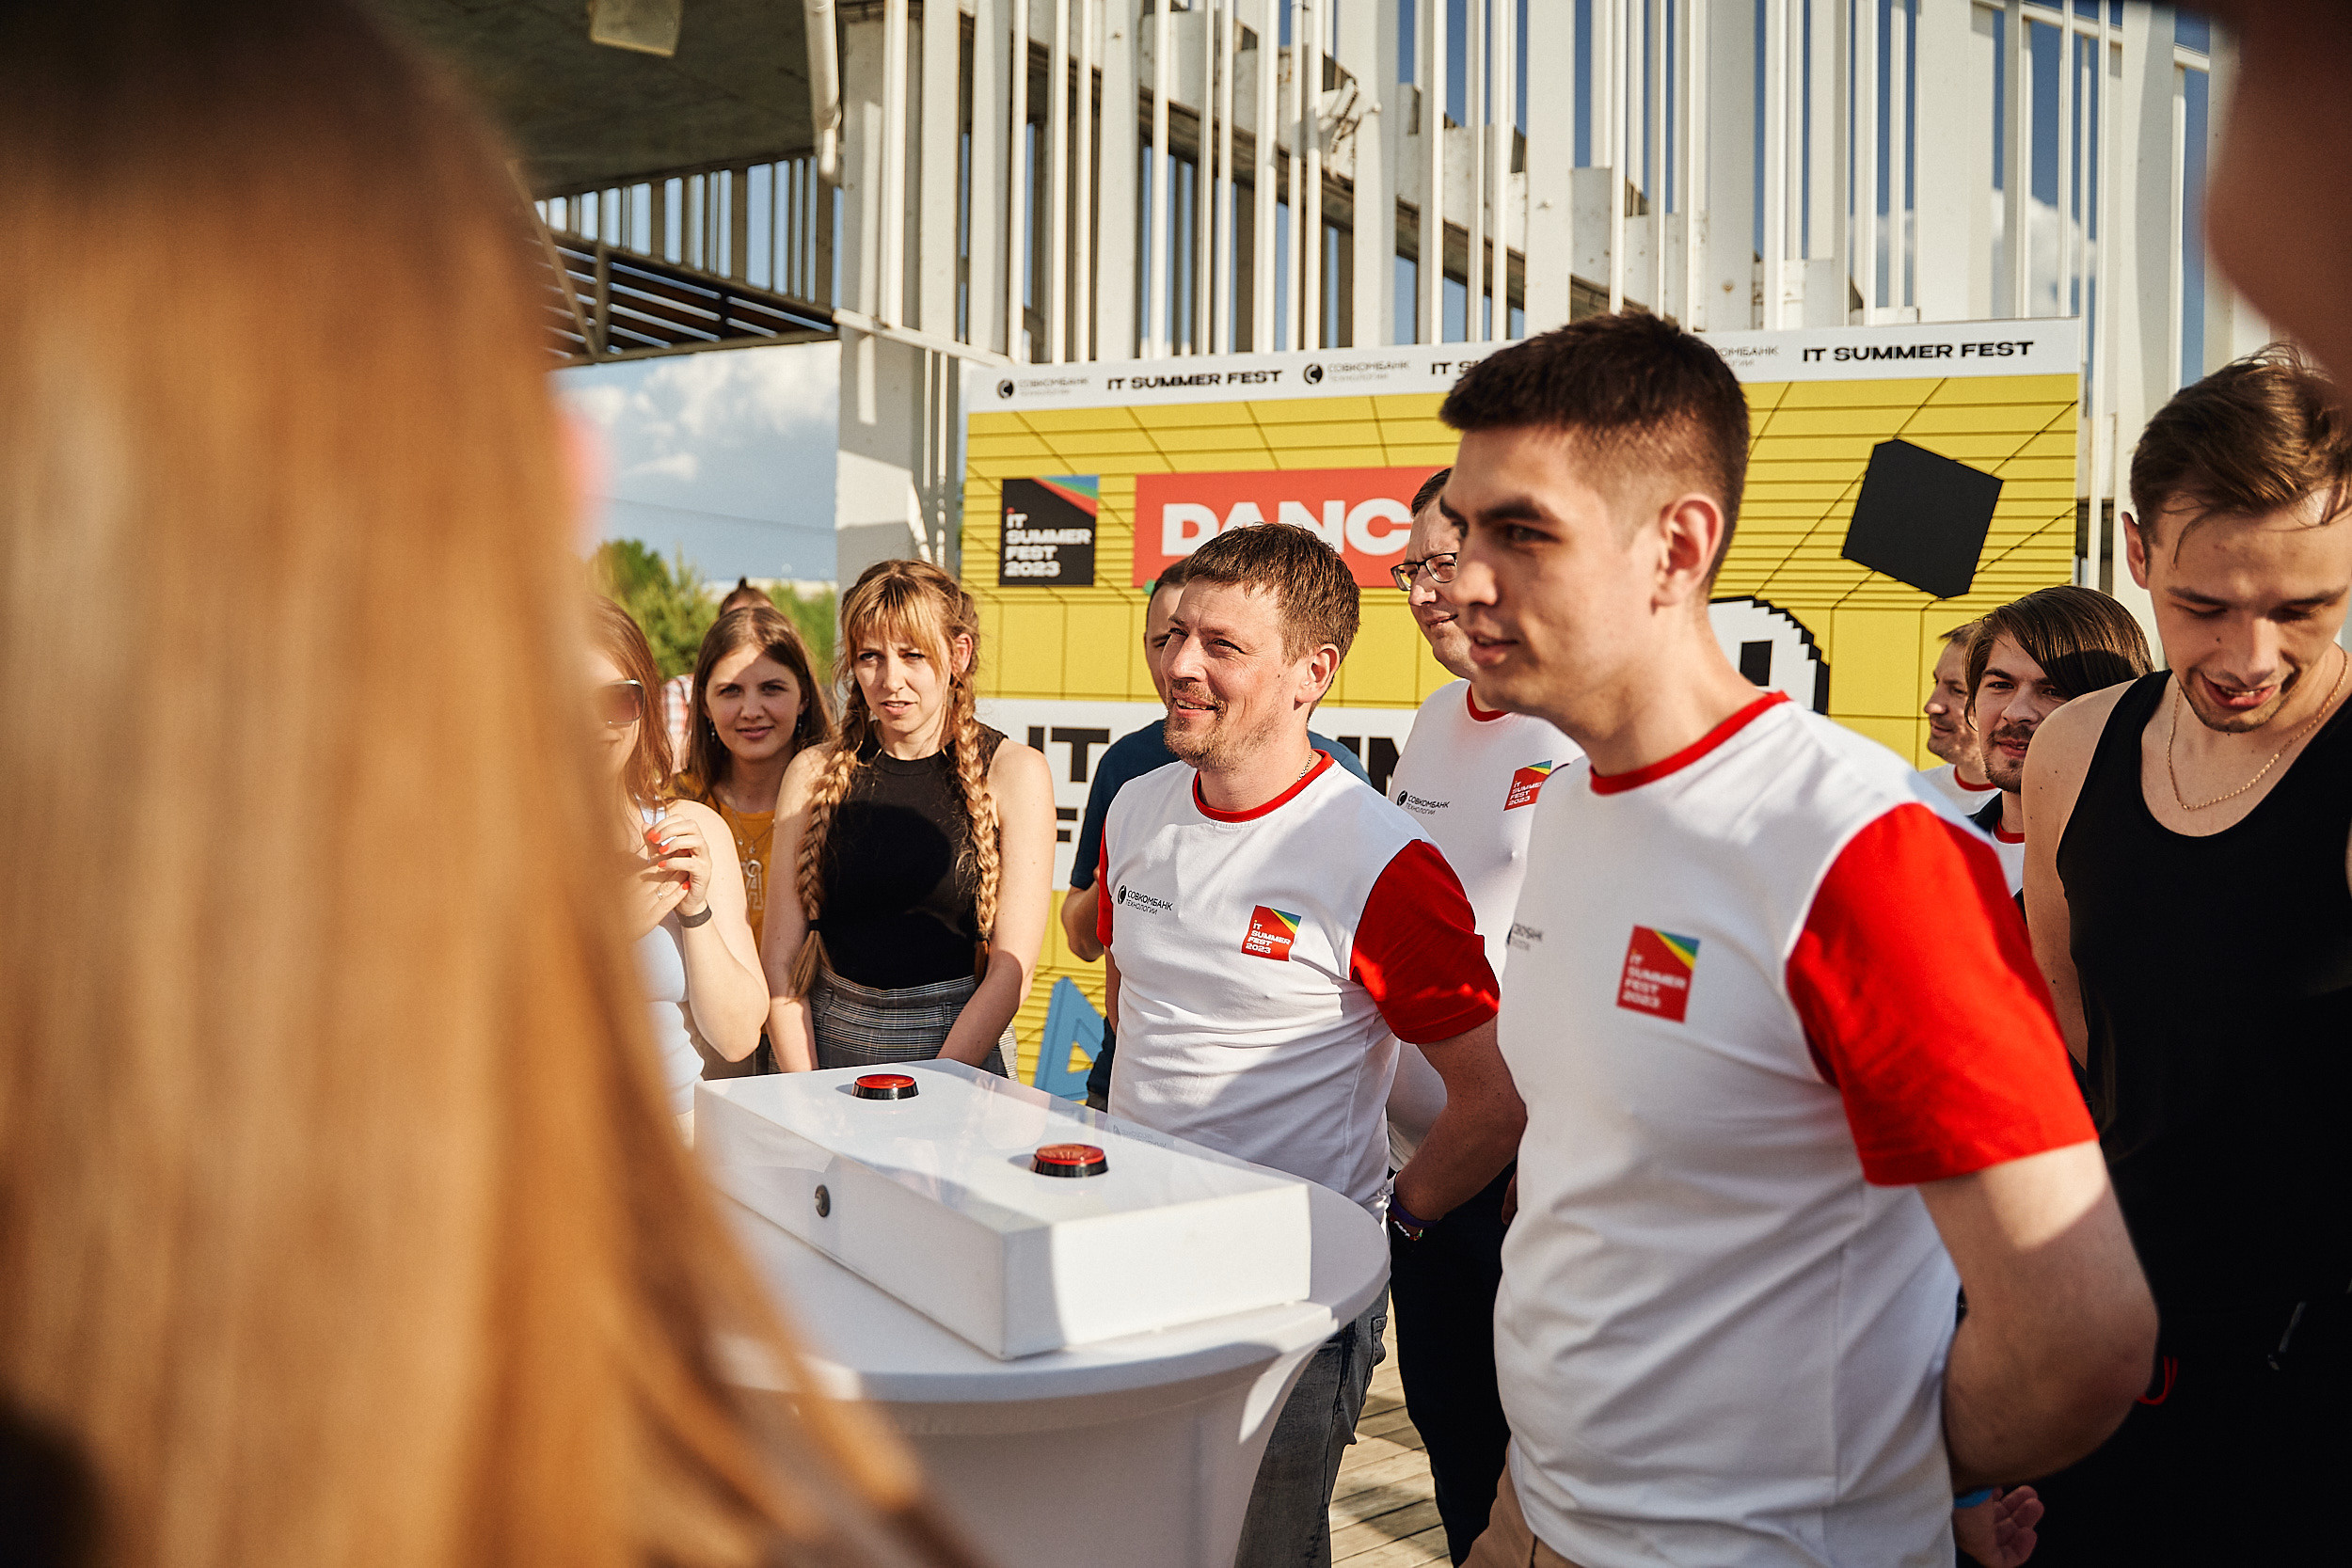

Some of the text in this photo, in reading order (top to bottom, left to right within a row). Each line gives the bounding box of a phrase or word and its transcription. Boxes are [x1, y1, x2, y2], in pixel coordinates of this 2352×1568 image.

[1803, 341, 2034, 362] IT SUMMER FEST
[1432, 362, 1452, 374] IT
[1107, 370, 1282, 390] IT SUMMER FEST
[1005, 529, 1092, 546] SUMMER
[1004, 545, 1058, 562] FEST
[1003, 560, 1061, 578] 2023
[1407, 795, 1451, 810] СОВКОМБАНК
[1507, 795, 1531, 806] 2023
[1509, 789, 1531, 800] FEST
[1125, 898, 1158, 915] ТЕХНОЛОГИИ
[1127, 890, 1174, 911] СОВКОМБАНК
[1247, 936, 1273, 946] FEST
[1250, 929, 1292, 945] SUMMER
[1245, 942, 1272, 954] 2023
